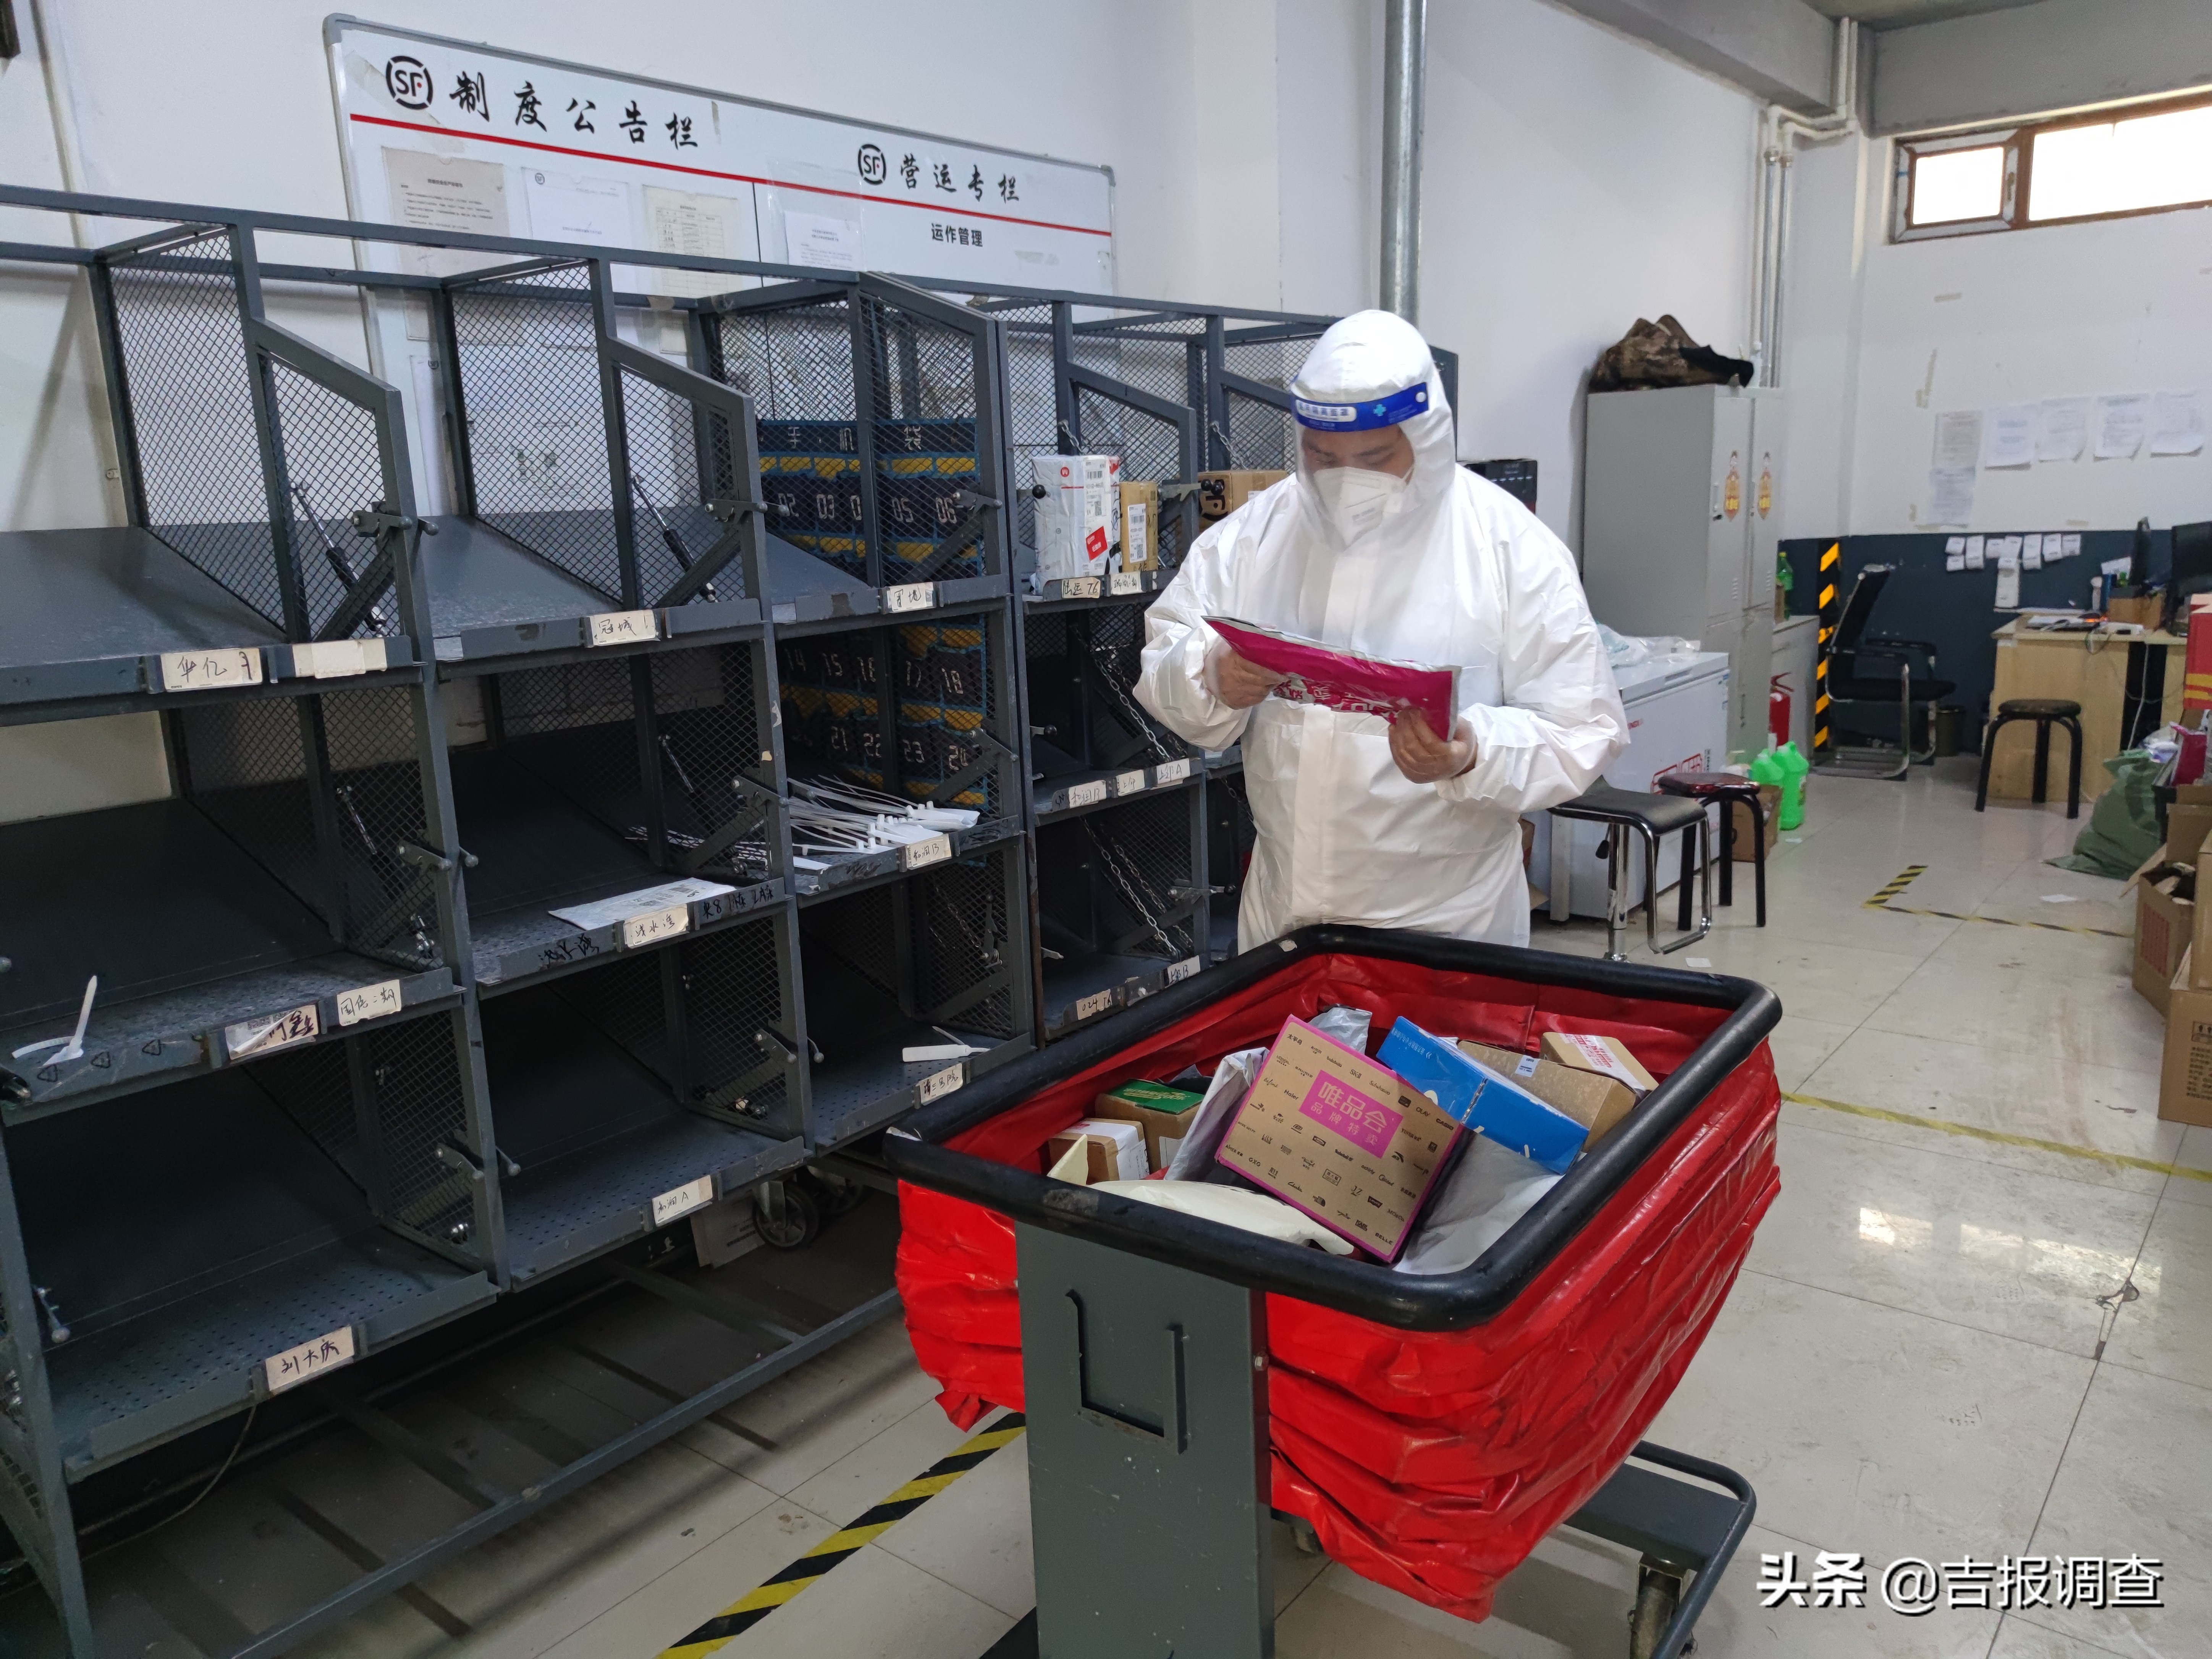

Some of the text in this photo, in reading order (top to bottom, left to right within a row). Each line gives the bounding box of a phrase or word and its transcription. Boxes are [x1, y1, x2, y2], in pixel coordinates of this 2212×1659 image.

[450, 71, 698, 150] 制度公告栏
[900, 154, 1020, 203] 营运专栏
[931, 223, 983, 247] 运作管理
[823, 653, 843, 676] 15
[1284, 1089, 1299, 1100] Haier
[1318, 1081, 1387, 1133] 唯品会
[1416, 1107, 1430, 1117] OLAY
[1311, 1101, 1378, 1146] 品牌特卖
[1436, 1118, 1454, 1130] CASIO
